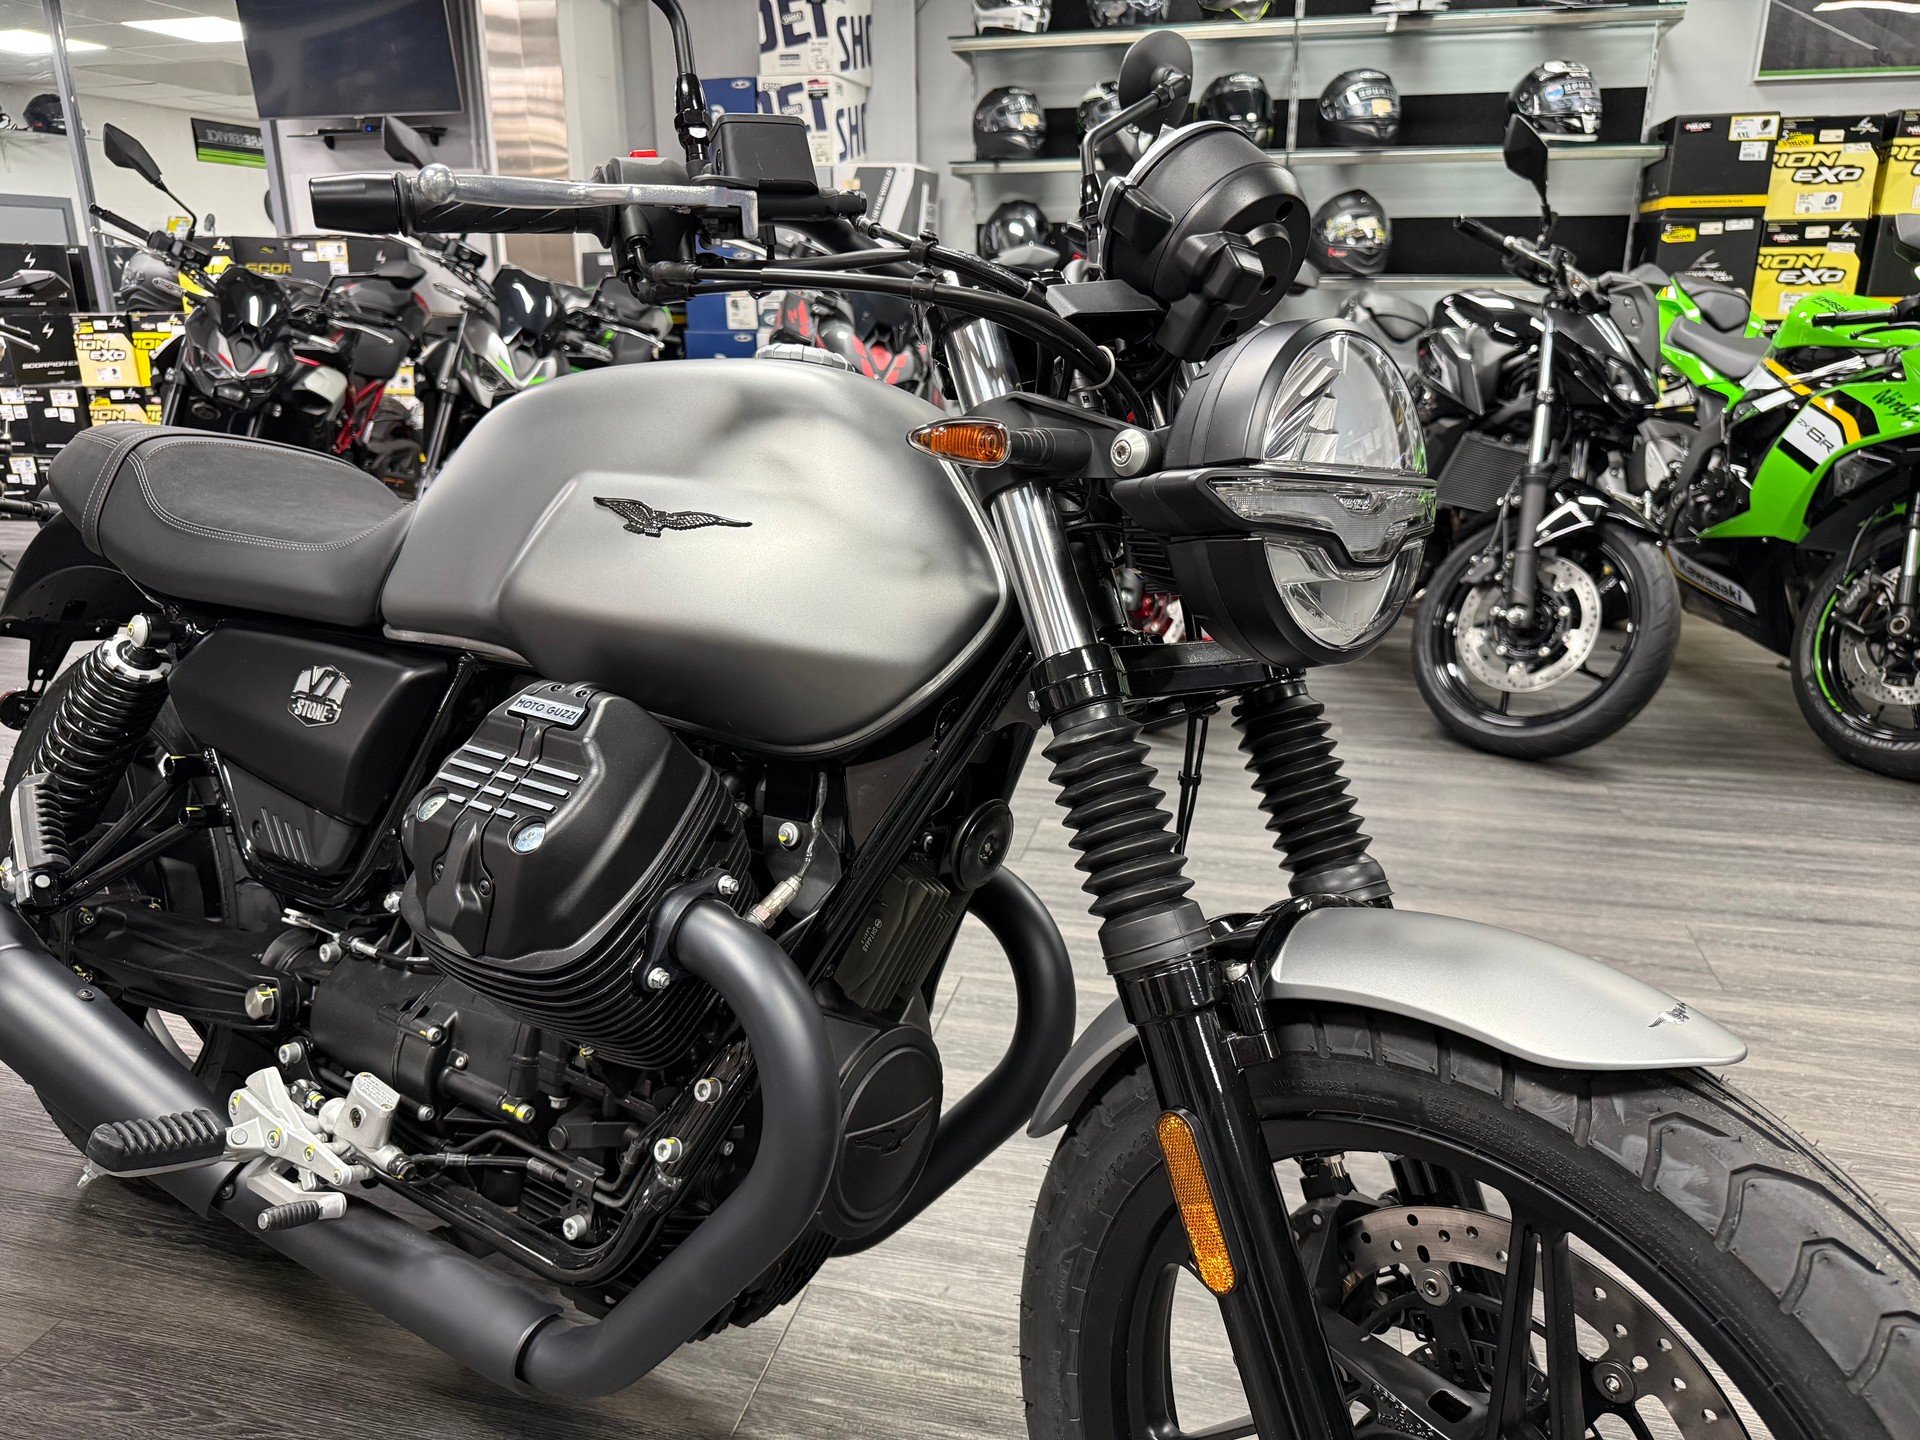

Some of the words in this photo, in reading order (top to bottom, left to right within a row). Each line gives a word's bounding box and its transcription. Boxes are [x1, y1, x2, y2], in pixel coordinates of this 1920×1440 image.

[837, 15, 872, 70] SH
[836, 103, 867, 161] SH
[1792, 165, 1864, 184] EXO
[1758, 254, 1825, 269] ION
[1776, 267, 1846, 285] EXO
[1678, 556, 1742, 603] Kawasaki
[294, 699, 331, 722] STONE
[515, 698, 545, 712] MOTO
[546, 707, 580, 721] GUZZI
